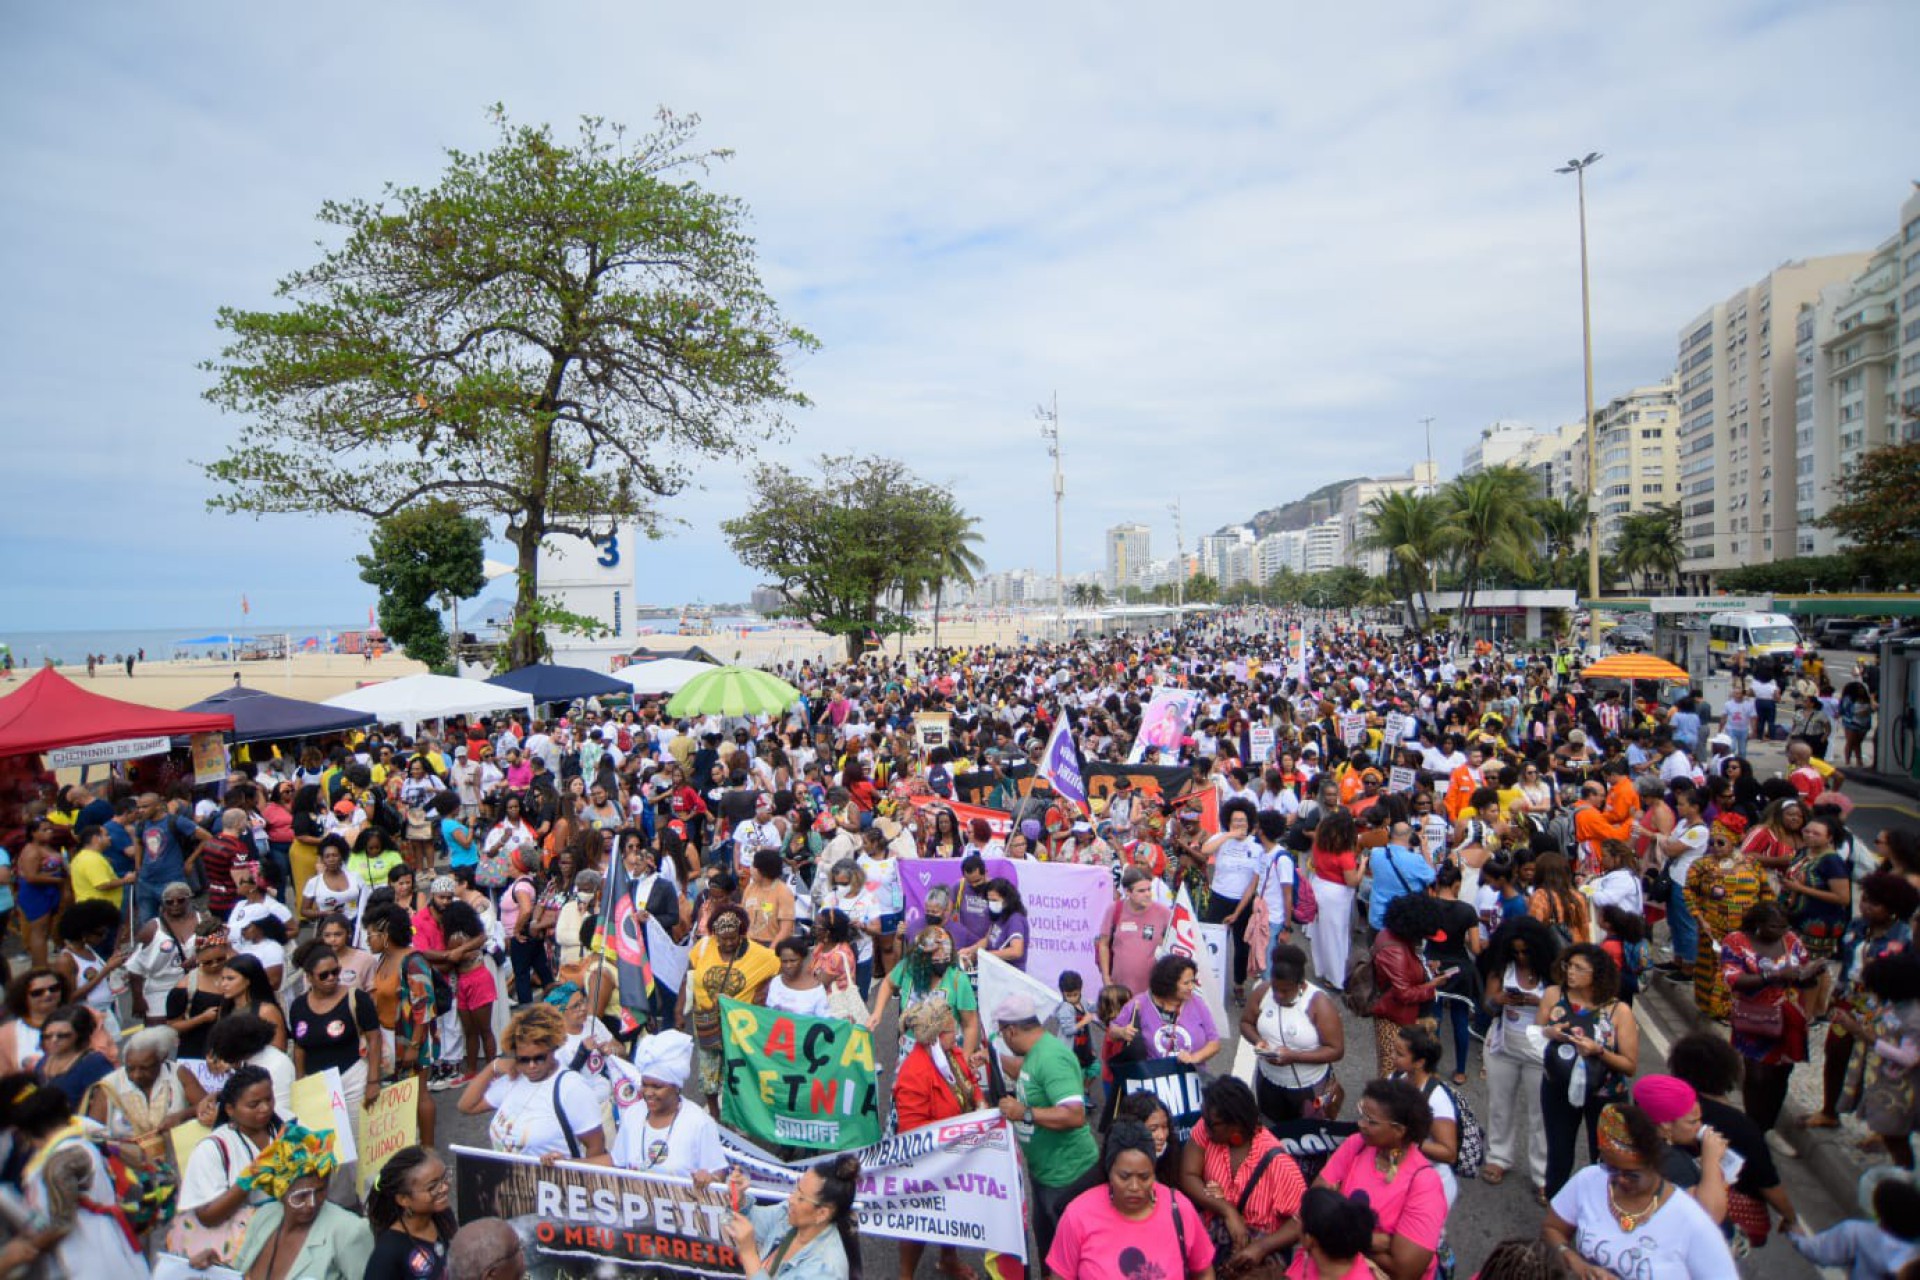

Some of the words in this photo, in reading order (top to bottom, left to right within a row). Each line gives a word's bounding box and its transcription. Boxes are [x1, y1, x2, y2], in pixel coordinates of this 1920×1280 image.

[597, 534, 619, 567] 3
[1029, 893, 1081, 910] RACISMO
[1030, 915, 1089, 932] VIOLÊNCIA
[727, 1008, 875, 1074] RAÇA
[727, 1058, 746, 1096] E
[758, 1069, 878, 1117] ETNIA
[883, 1176, 897, 1196] E
[903, 1177, 939, 1194] NA
[943, 1173, 1007, 1199] LUTA:
[536, 1180, 734, 1245] RESPEIT
[901, 1196, 946, 1211] FOME!
[873, 1213, 883, 1226] O
[887, 1213, 986, 1240] CAPITALISMO!
[536, 1222, 555, 1243] O
[565, 1225, 614, 1250] MEU
[623, 1232, 741, 1267] TERREIR
